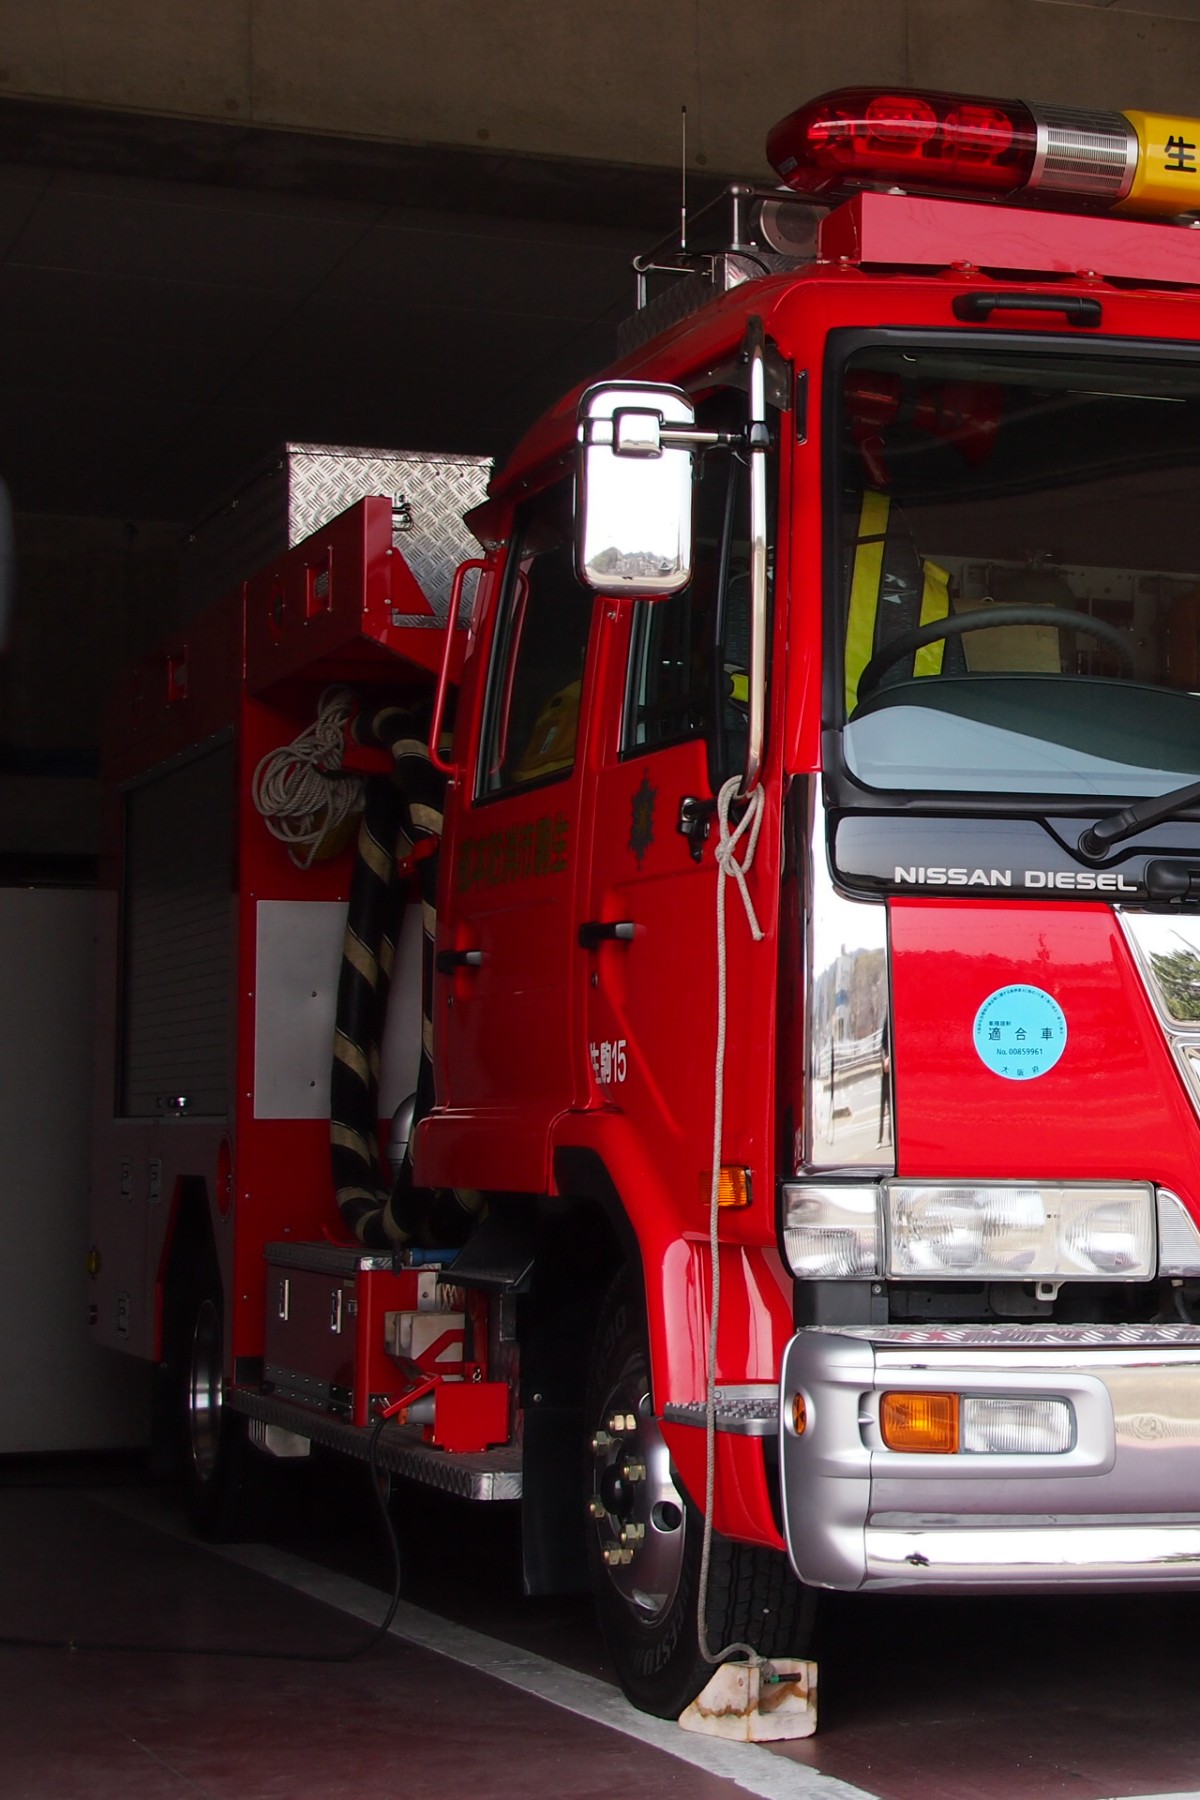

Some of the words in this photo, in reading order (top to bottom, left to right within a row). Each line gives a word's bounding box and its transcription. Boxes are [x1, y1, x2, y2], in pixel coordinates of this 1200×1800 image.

[894, 866, 1011, 887] NISSAN
[1024, 870, 1137, 892] DIESEL
[988, 1027, 1053, 1041] 適合車
[589, 1039, 627, 1085] 生駒15
